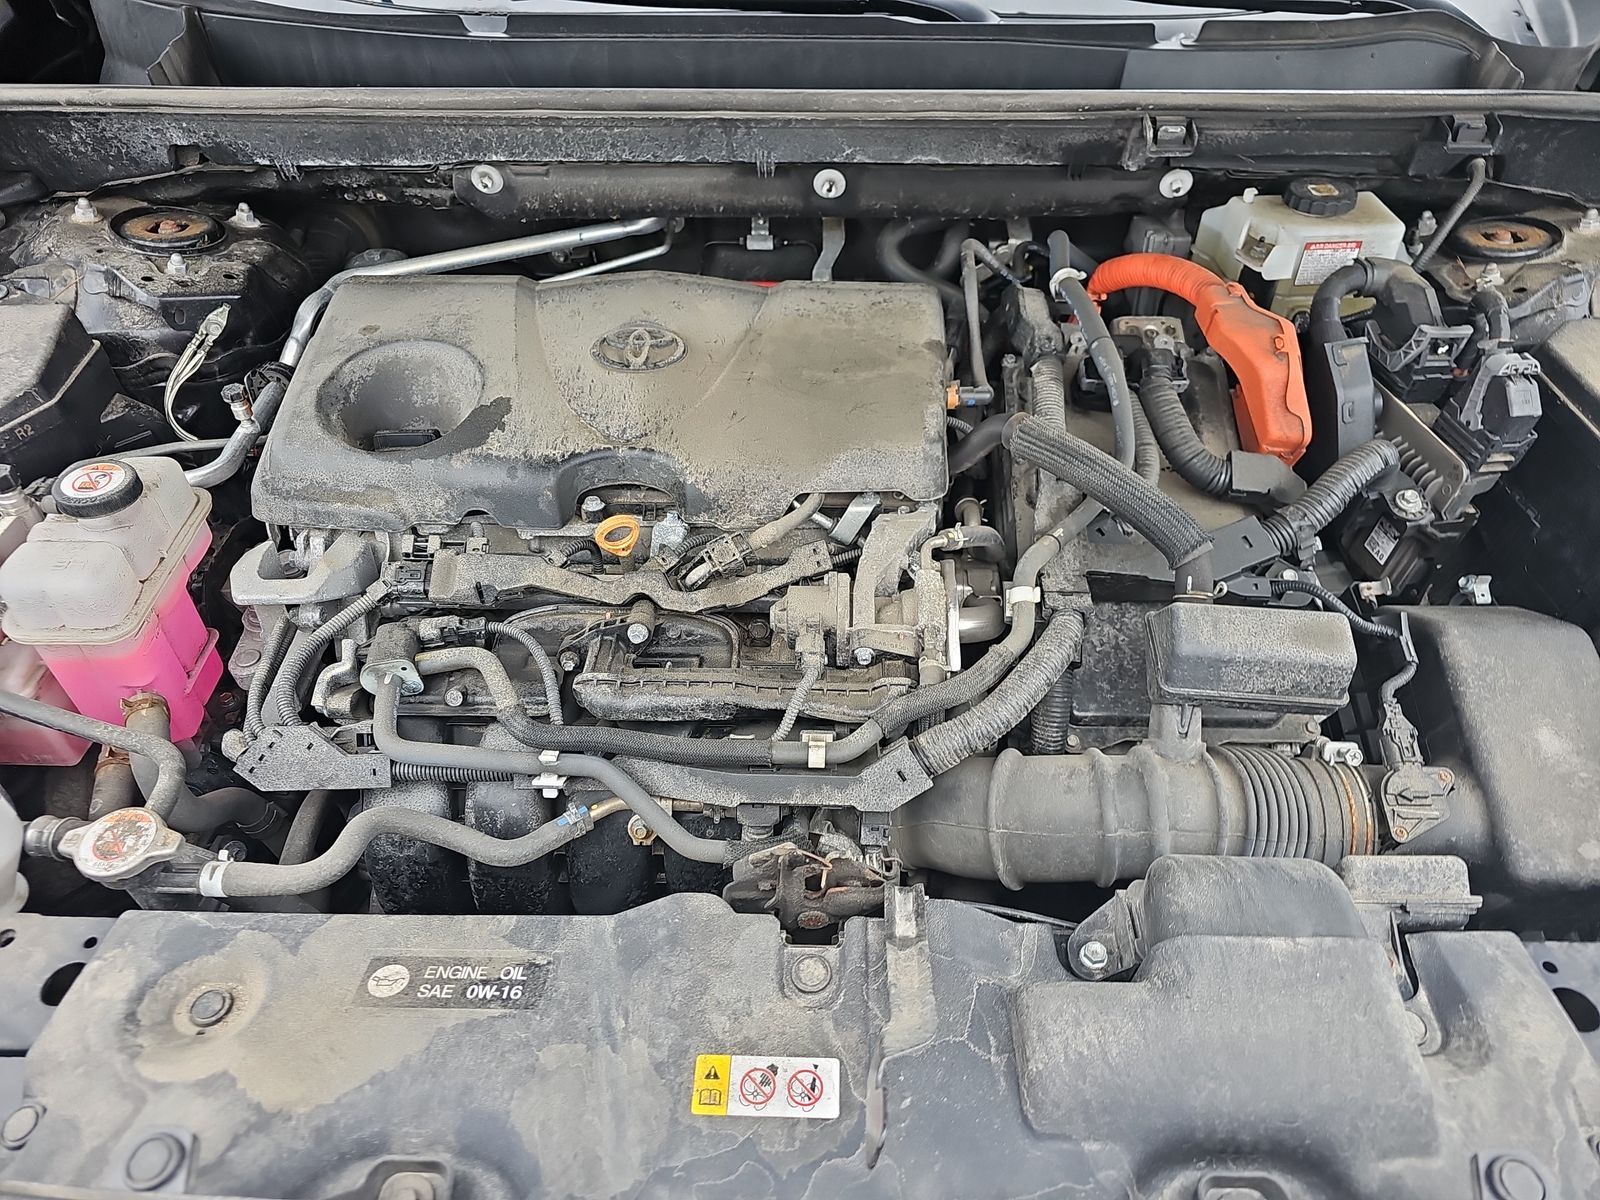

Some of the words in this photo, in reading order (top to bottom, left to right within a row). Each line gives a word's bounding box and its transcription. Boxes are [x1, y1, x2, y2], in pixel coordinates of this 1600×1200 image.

[14, 424, 35, 440] R2
[424, 966, 488, 979] ENGINE
[501, 966, 527, 980] OIL
[417, 984, 455, 998] SAE
[466, 985, 523, 999] 0W-16
